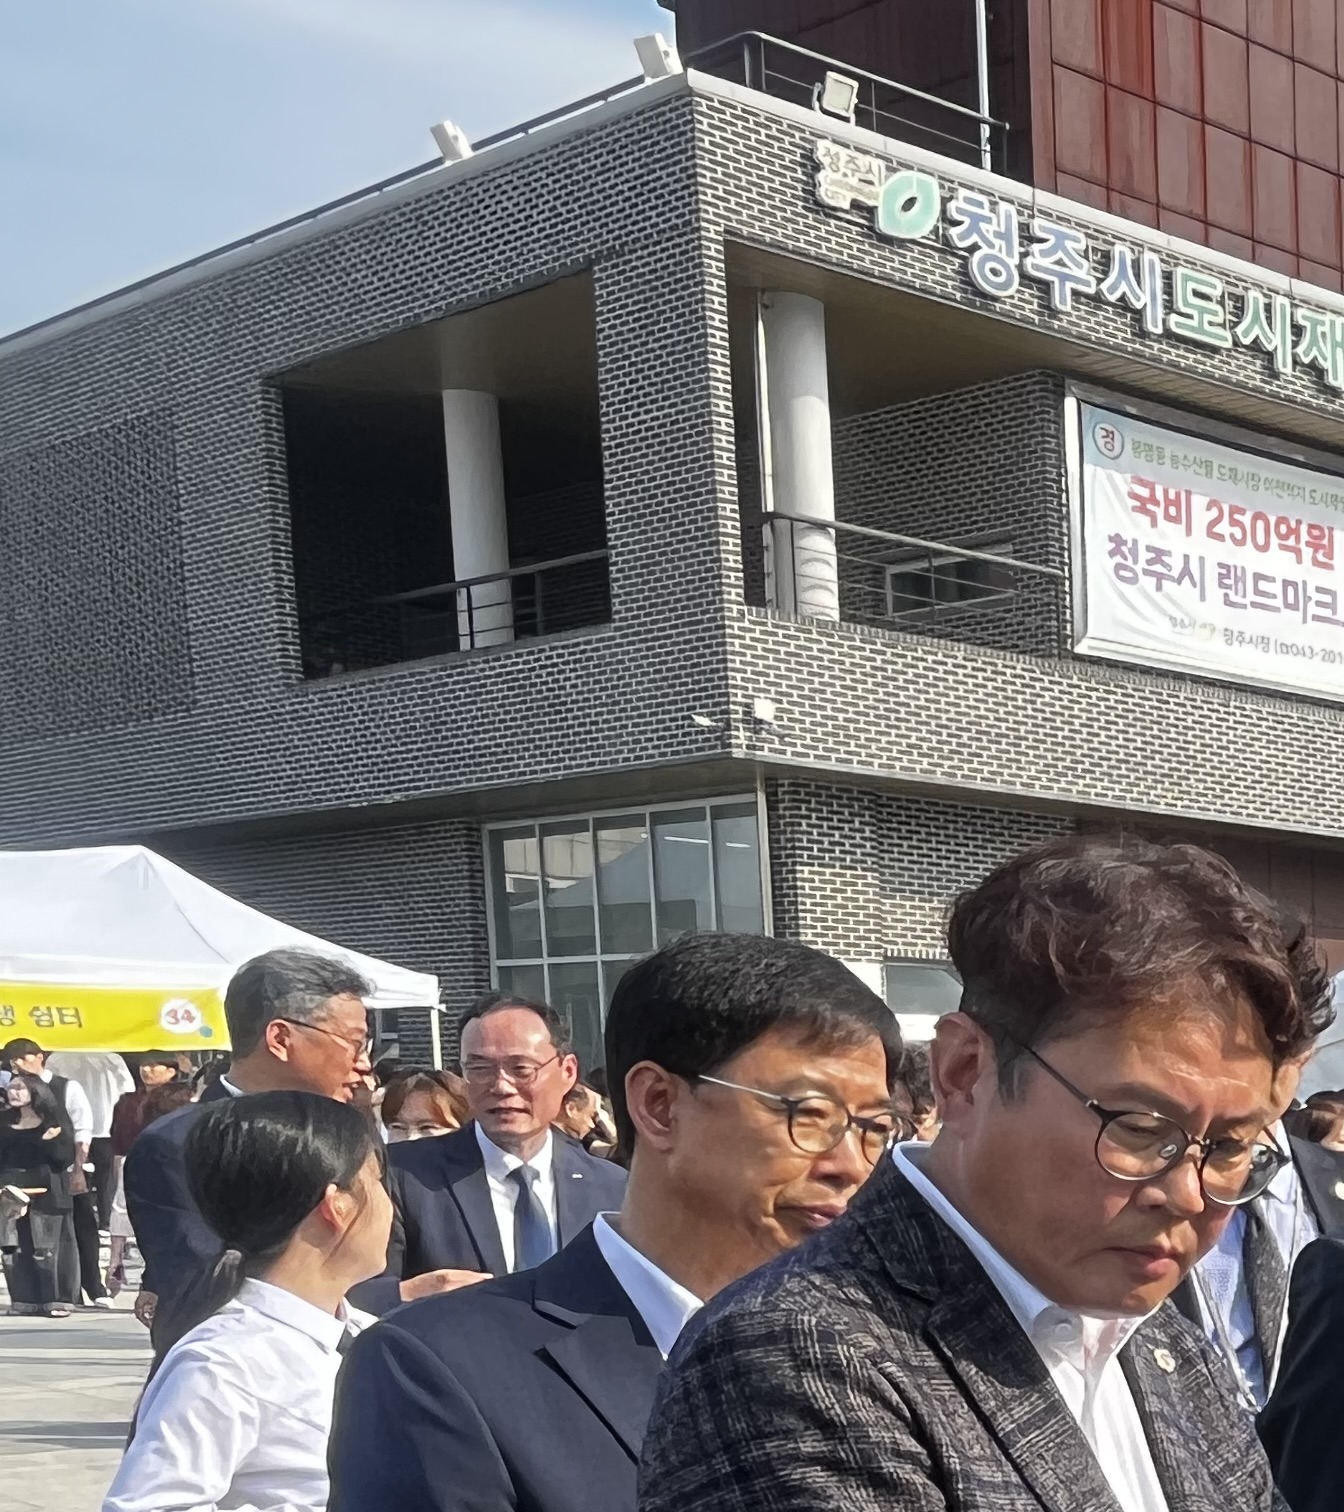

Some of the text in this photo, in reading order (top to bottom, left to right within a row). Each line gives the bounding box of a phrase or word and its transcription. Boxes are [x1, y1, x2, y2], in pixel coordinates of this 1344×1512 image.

[1100, 427, 1115, 452] 경
[1127, 474, 1192, 537] 국비
[1205, 499, 1335, 571] 250억원
[1107, 533, 1206, 603] 청주시
[28, 1006, 82, 1028] 쉼터
